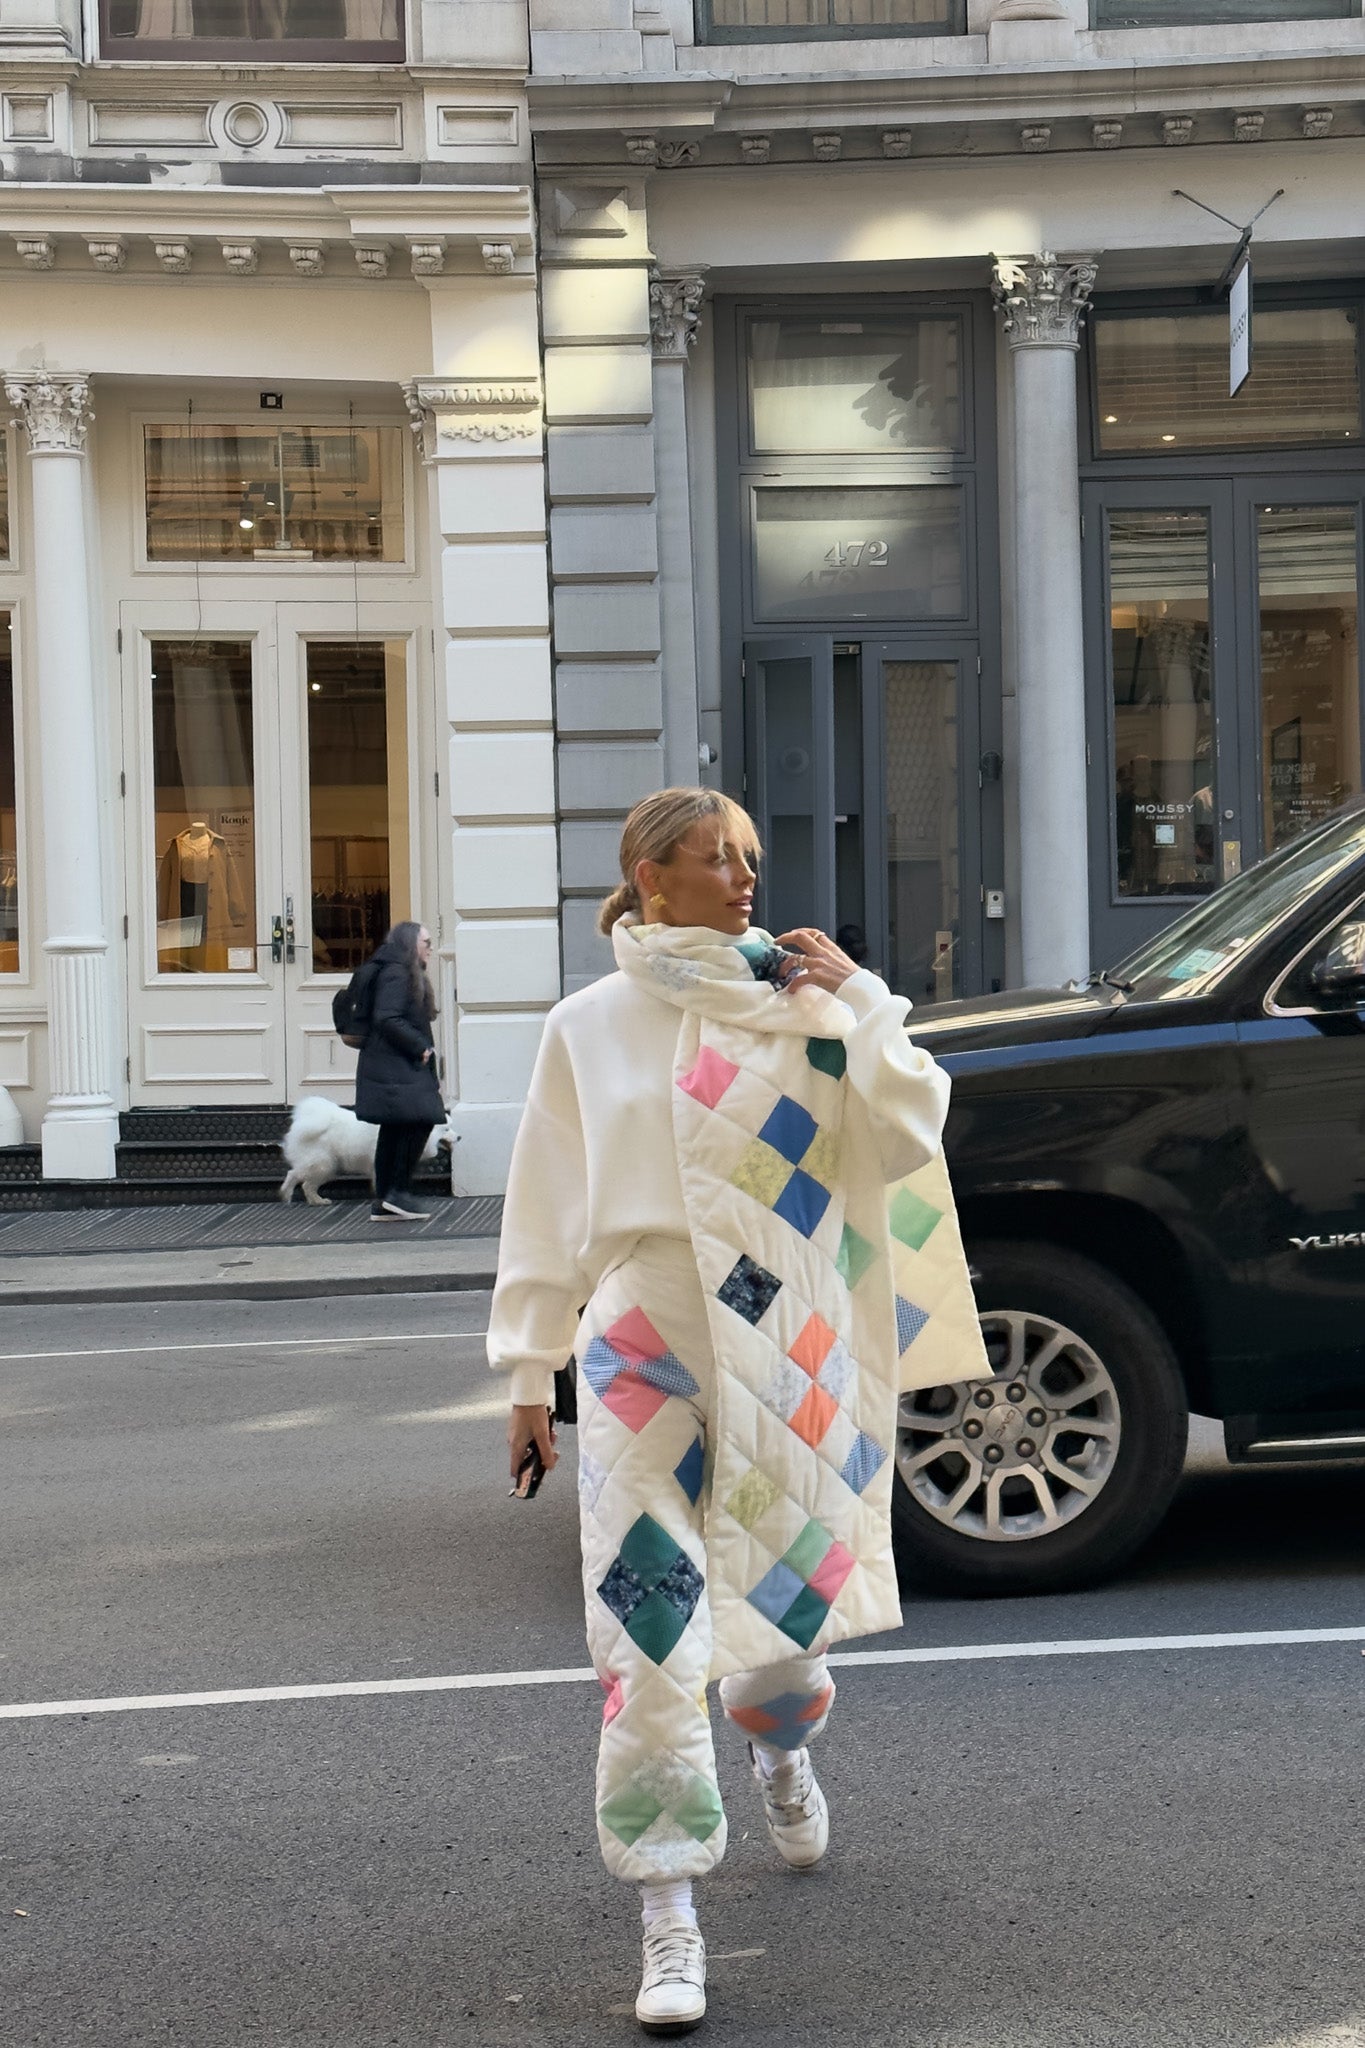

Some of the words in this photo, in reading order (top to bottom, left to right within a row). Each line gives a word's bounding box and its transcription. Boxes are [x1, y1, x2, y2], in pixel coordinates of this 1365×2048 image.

[824, 540, 889, 567] 472
[1135, 804, 1195, 814] MOUSSY
[1288, 1232, 1365, 1250] YUK
